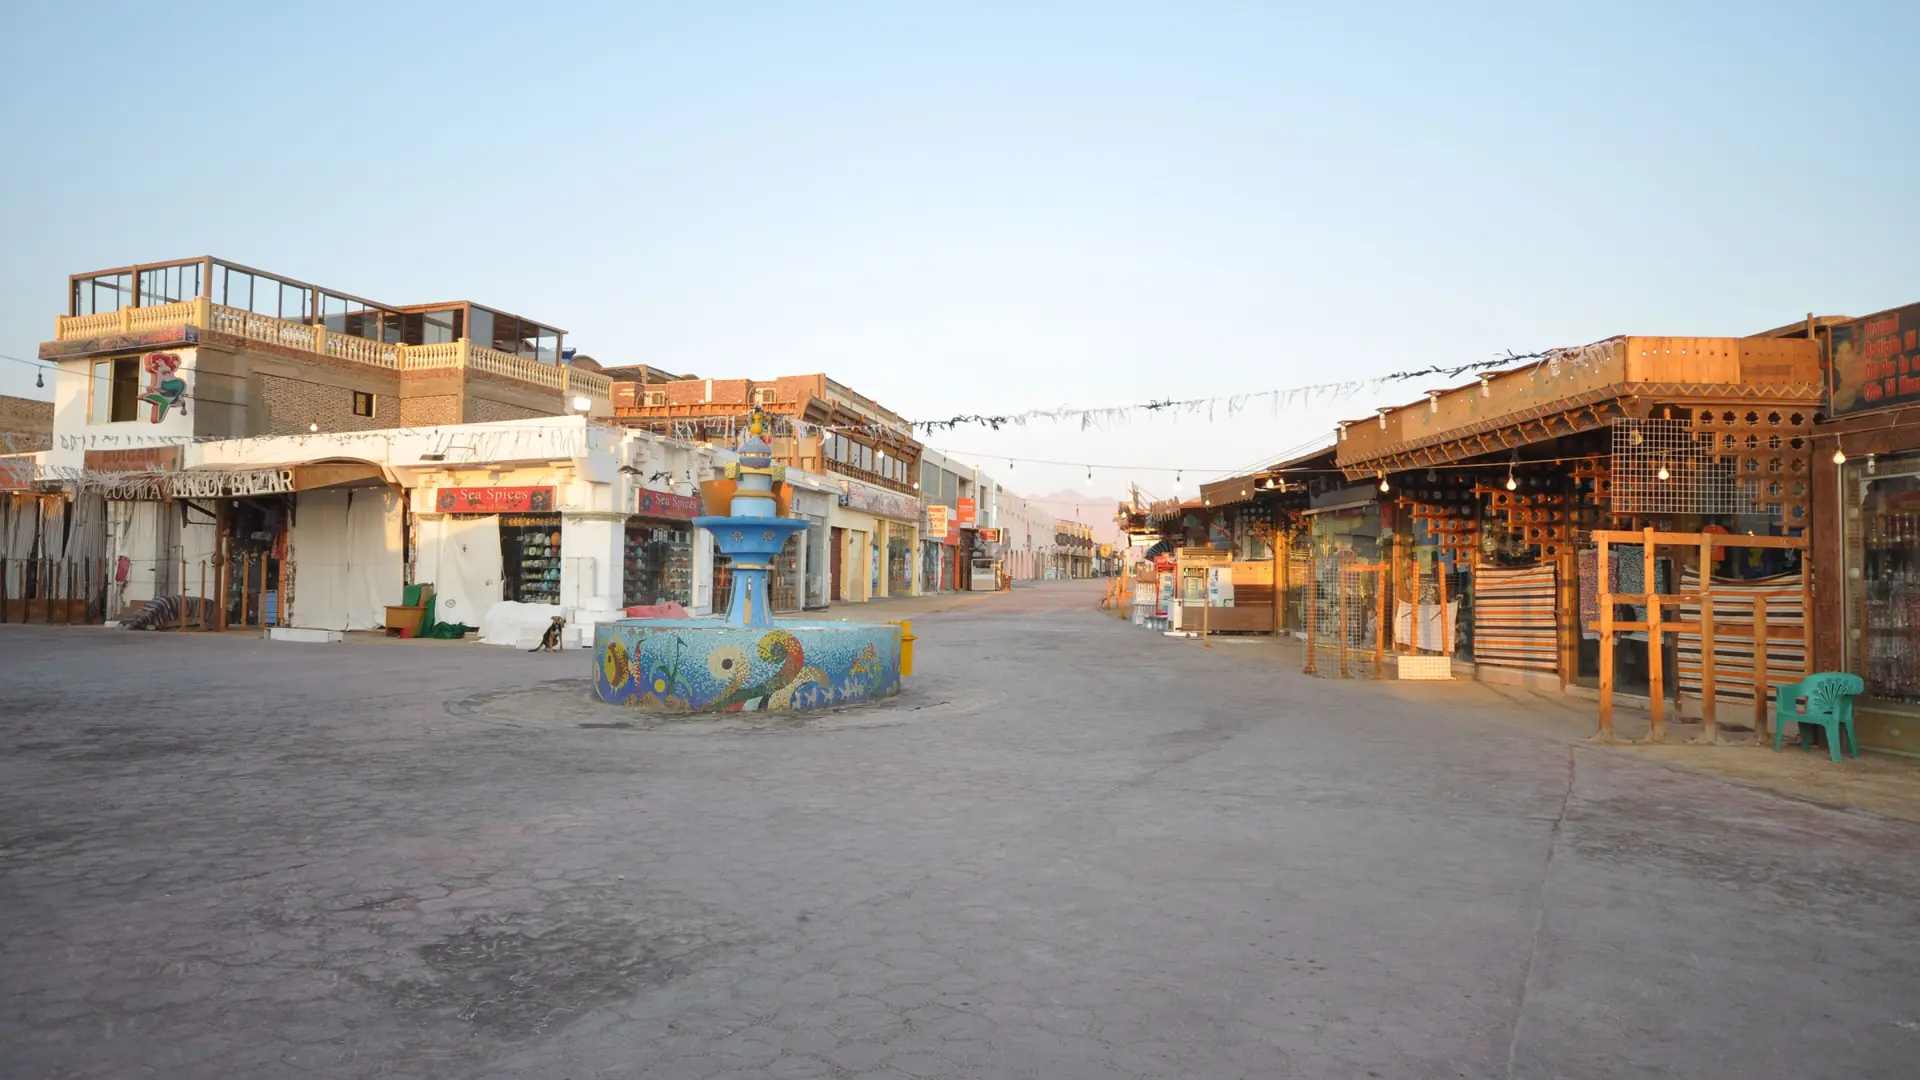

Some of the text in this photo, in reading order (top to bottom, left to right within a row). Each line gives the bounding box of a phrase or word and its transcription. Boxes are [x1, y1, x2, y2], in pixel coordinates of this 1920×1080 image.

[231, 469, 294, 495] BAZAR
[459, 488, 528, 502] Sea Spices
[655, 493, 697, 509] Sea Spices
